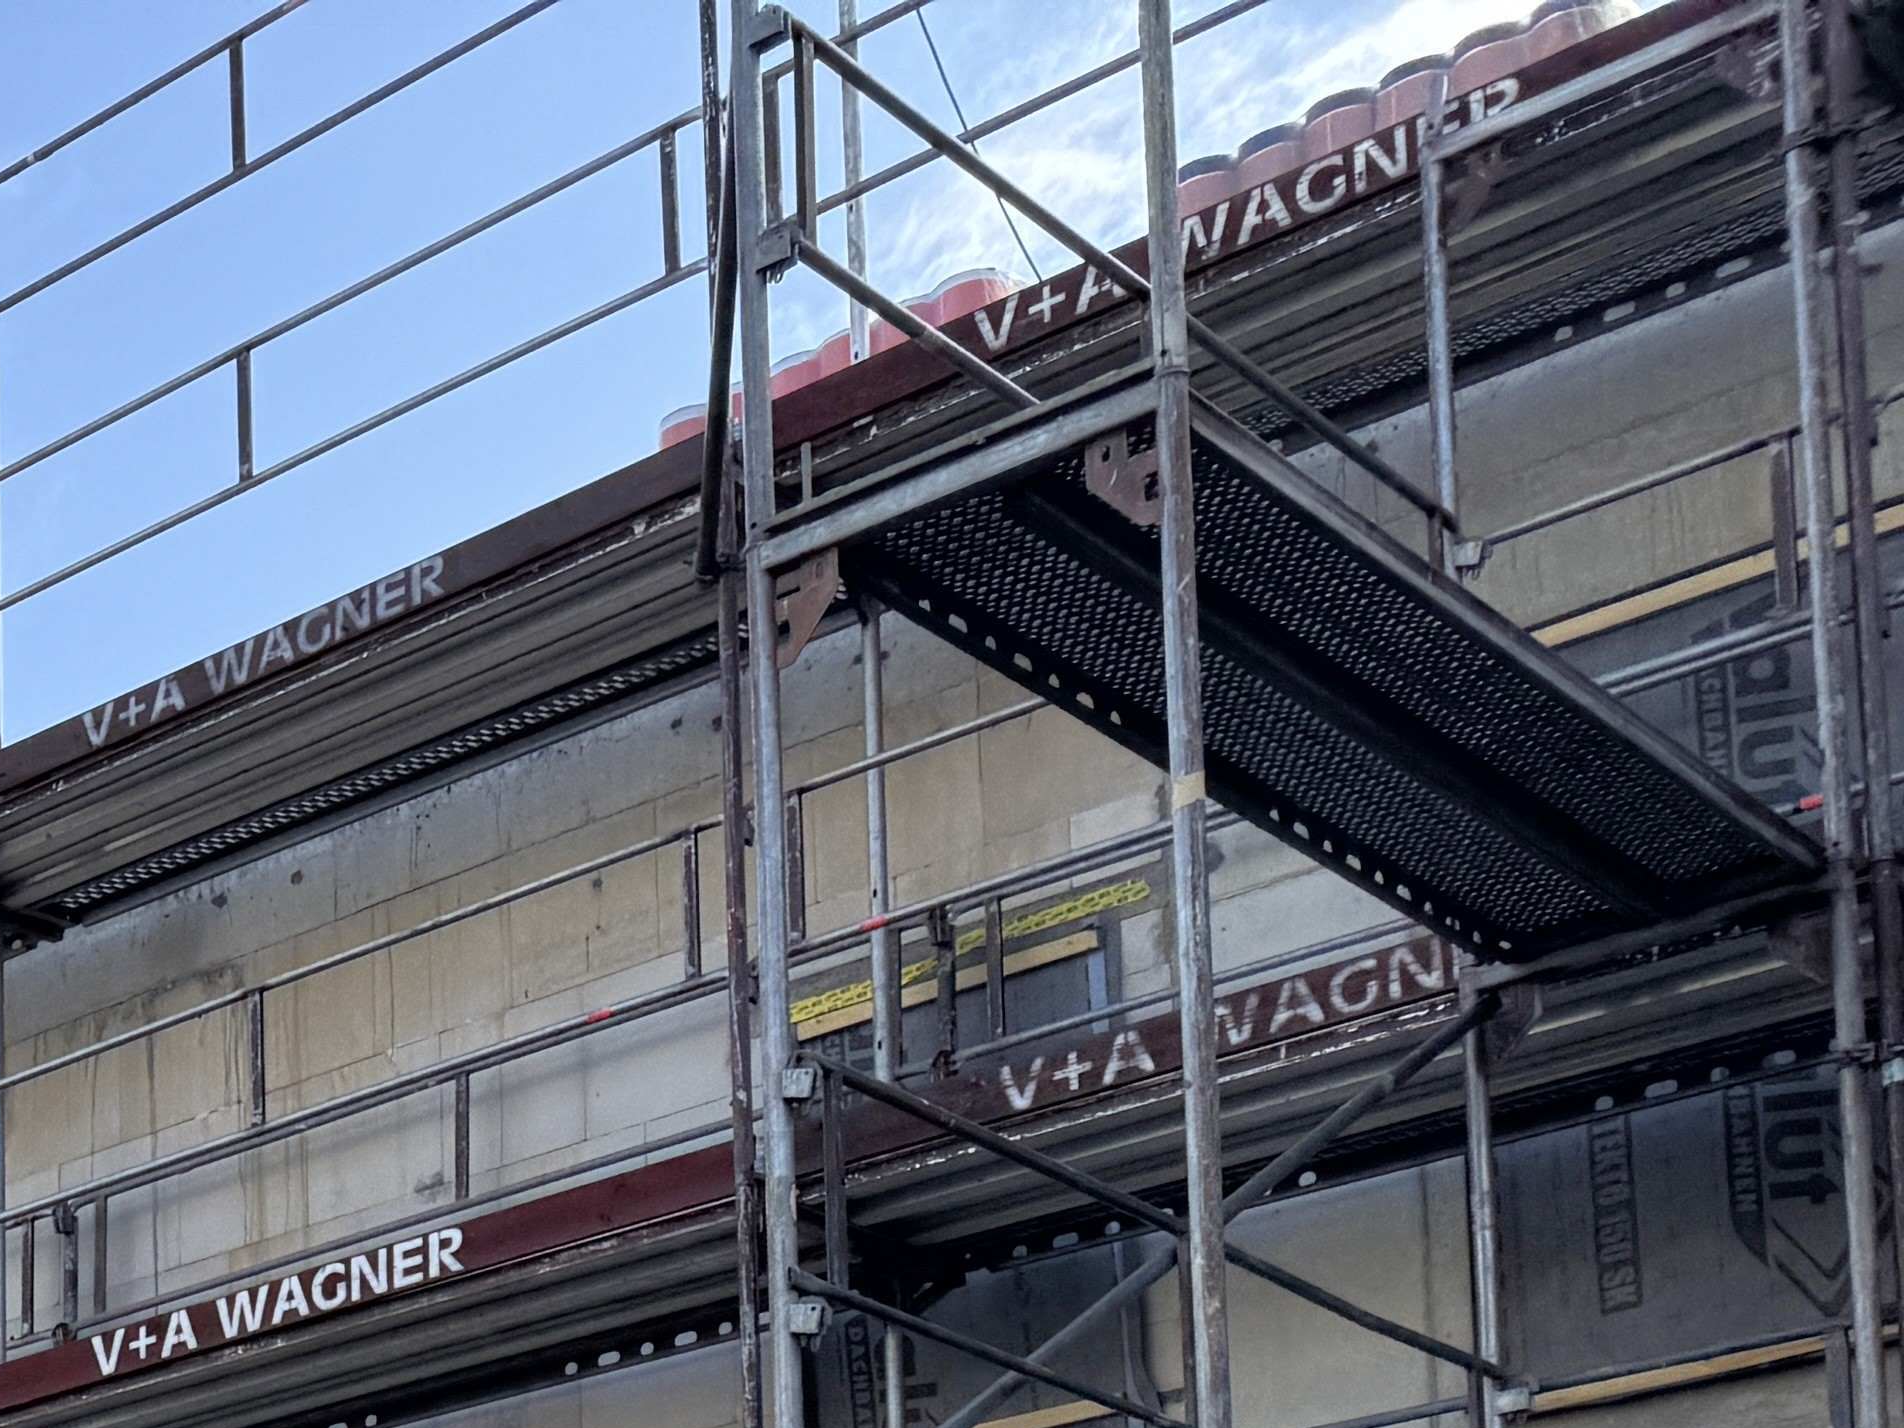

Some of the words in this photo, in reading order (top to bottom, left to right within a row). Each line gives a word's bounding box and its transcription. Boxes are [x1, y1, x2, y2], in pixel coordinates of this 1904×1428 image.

[82, 675, 187, 749] V+A
[204, 555, 447, 695] WAGNER
[999, 1029, 1156, 1111] V+A
[91, 1310, 199, 1376] V+A
[215, 1227, 465, 1338] WAGNER
